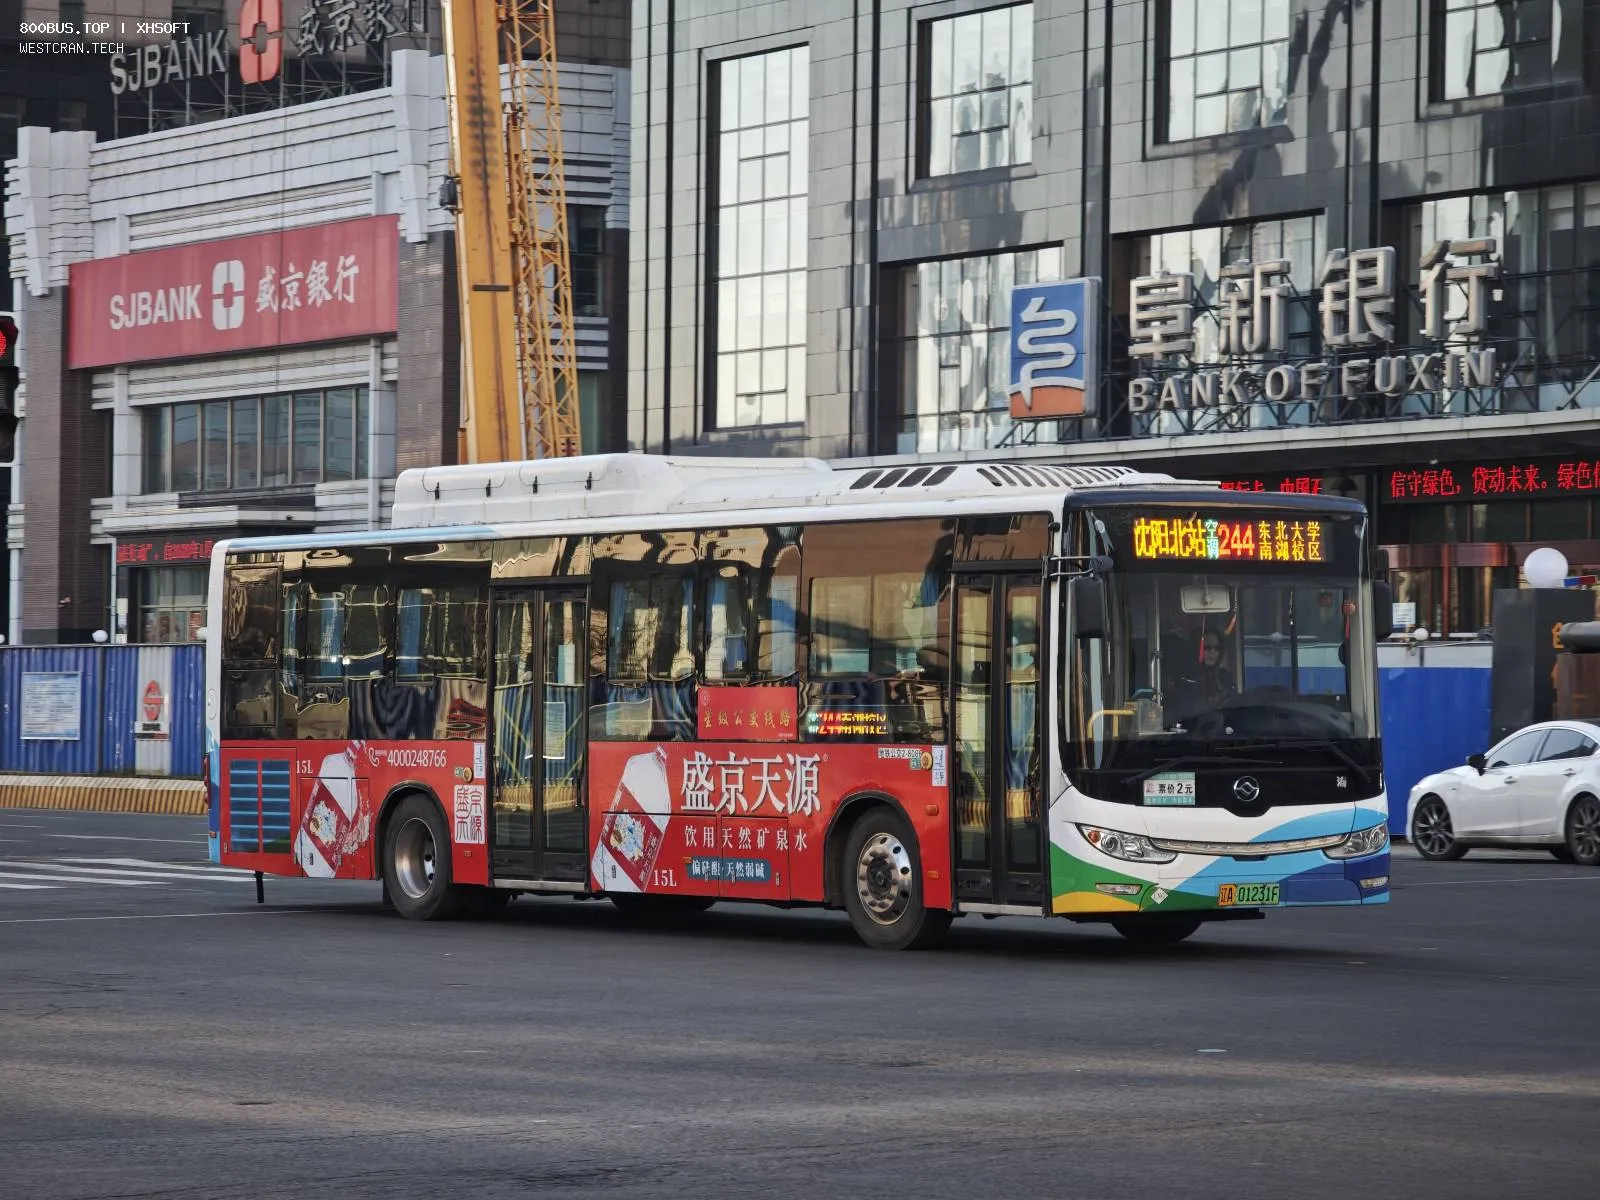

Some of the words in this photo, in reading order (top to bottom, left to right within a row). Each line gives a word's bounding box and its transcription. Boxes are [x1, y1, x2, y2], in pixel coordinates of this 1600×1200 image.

[110, 29, 227, 95] SJBANK
[110, 284, 202, 330] SJBANK
[1127, 237, 1500, 361] 阜新银行
[1128, 369, 1250, 415] BANK
[1265, 362, 1329, 404] OF
[1341, 348, 1497, 400] FUXIN
[1134, 517, 1206, 559] 沈阳北站
[1217, 524, 1255, 557] 244
[1258, 520, 1321, 541] 东北大学
[1258, 541, 1322, 561] 南湖校区
[296, 760, 313, 774] 15L
[387, 749, 447, 768] 4000248766
[680, 750, 821, 816] 盛京天源
[684, 825, 808, 852] 饮用天然矿泉水
[653, 869, 677, 887] 15L
